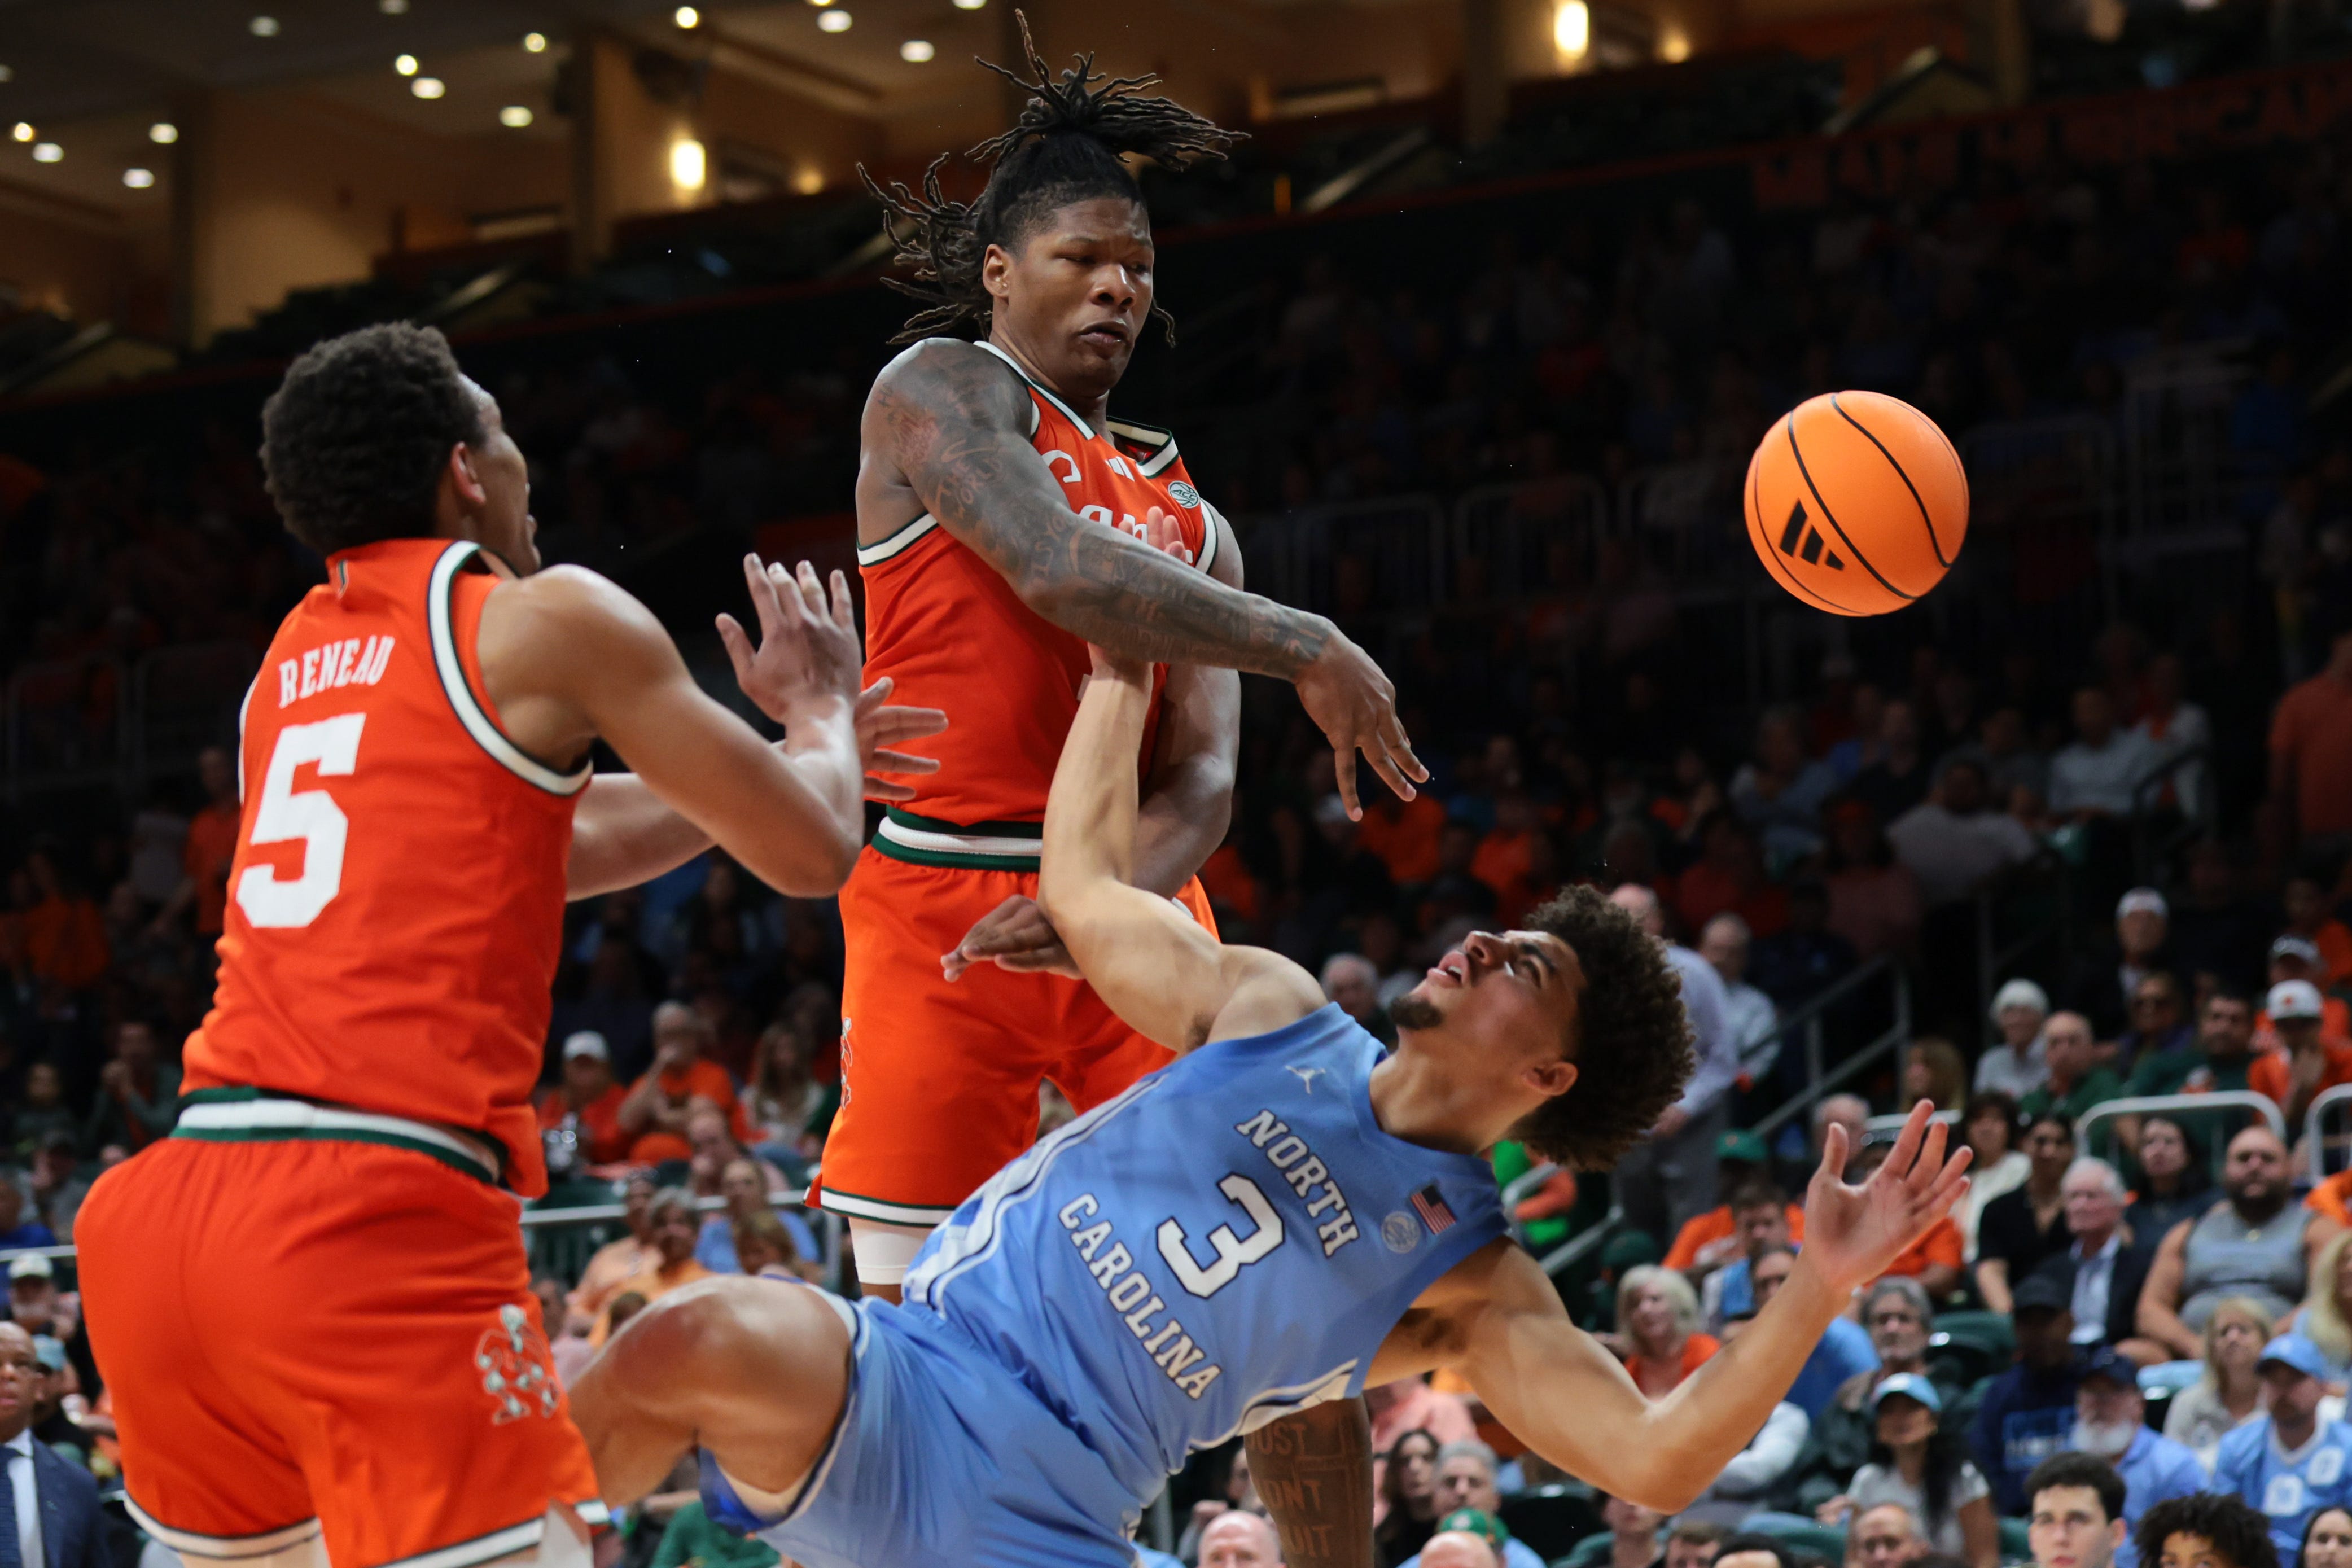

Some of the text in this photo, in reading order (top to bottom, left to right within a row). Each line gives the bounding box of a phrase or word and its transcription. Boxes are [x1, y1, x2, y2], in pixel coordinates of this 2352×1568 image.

[236, 711, 367, 928] 5
[1156, 1171, 1285, 1300] 3
[1234, 1108, 1360, 1259] NORTH
[1058, 1192, 1223, 1400] CAROLINA
